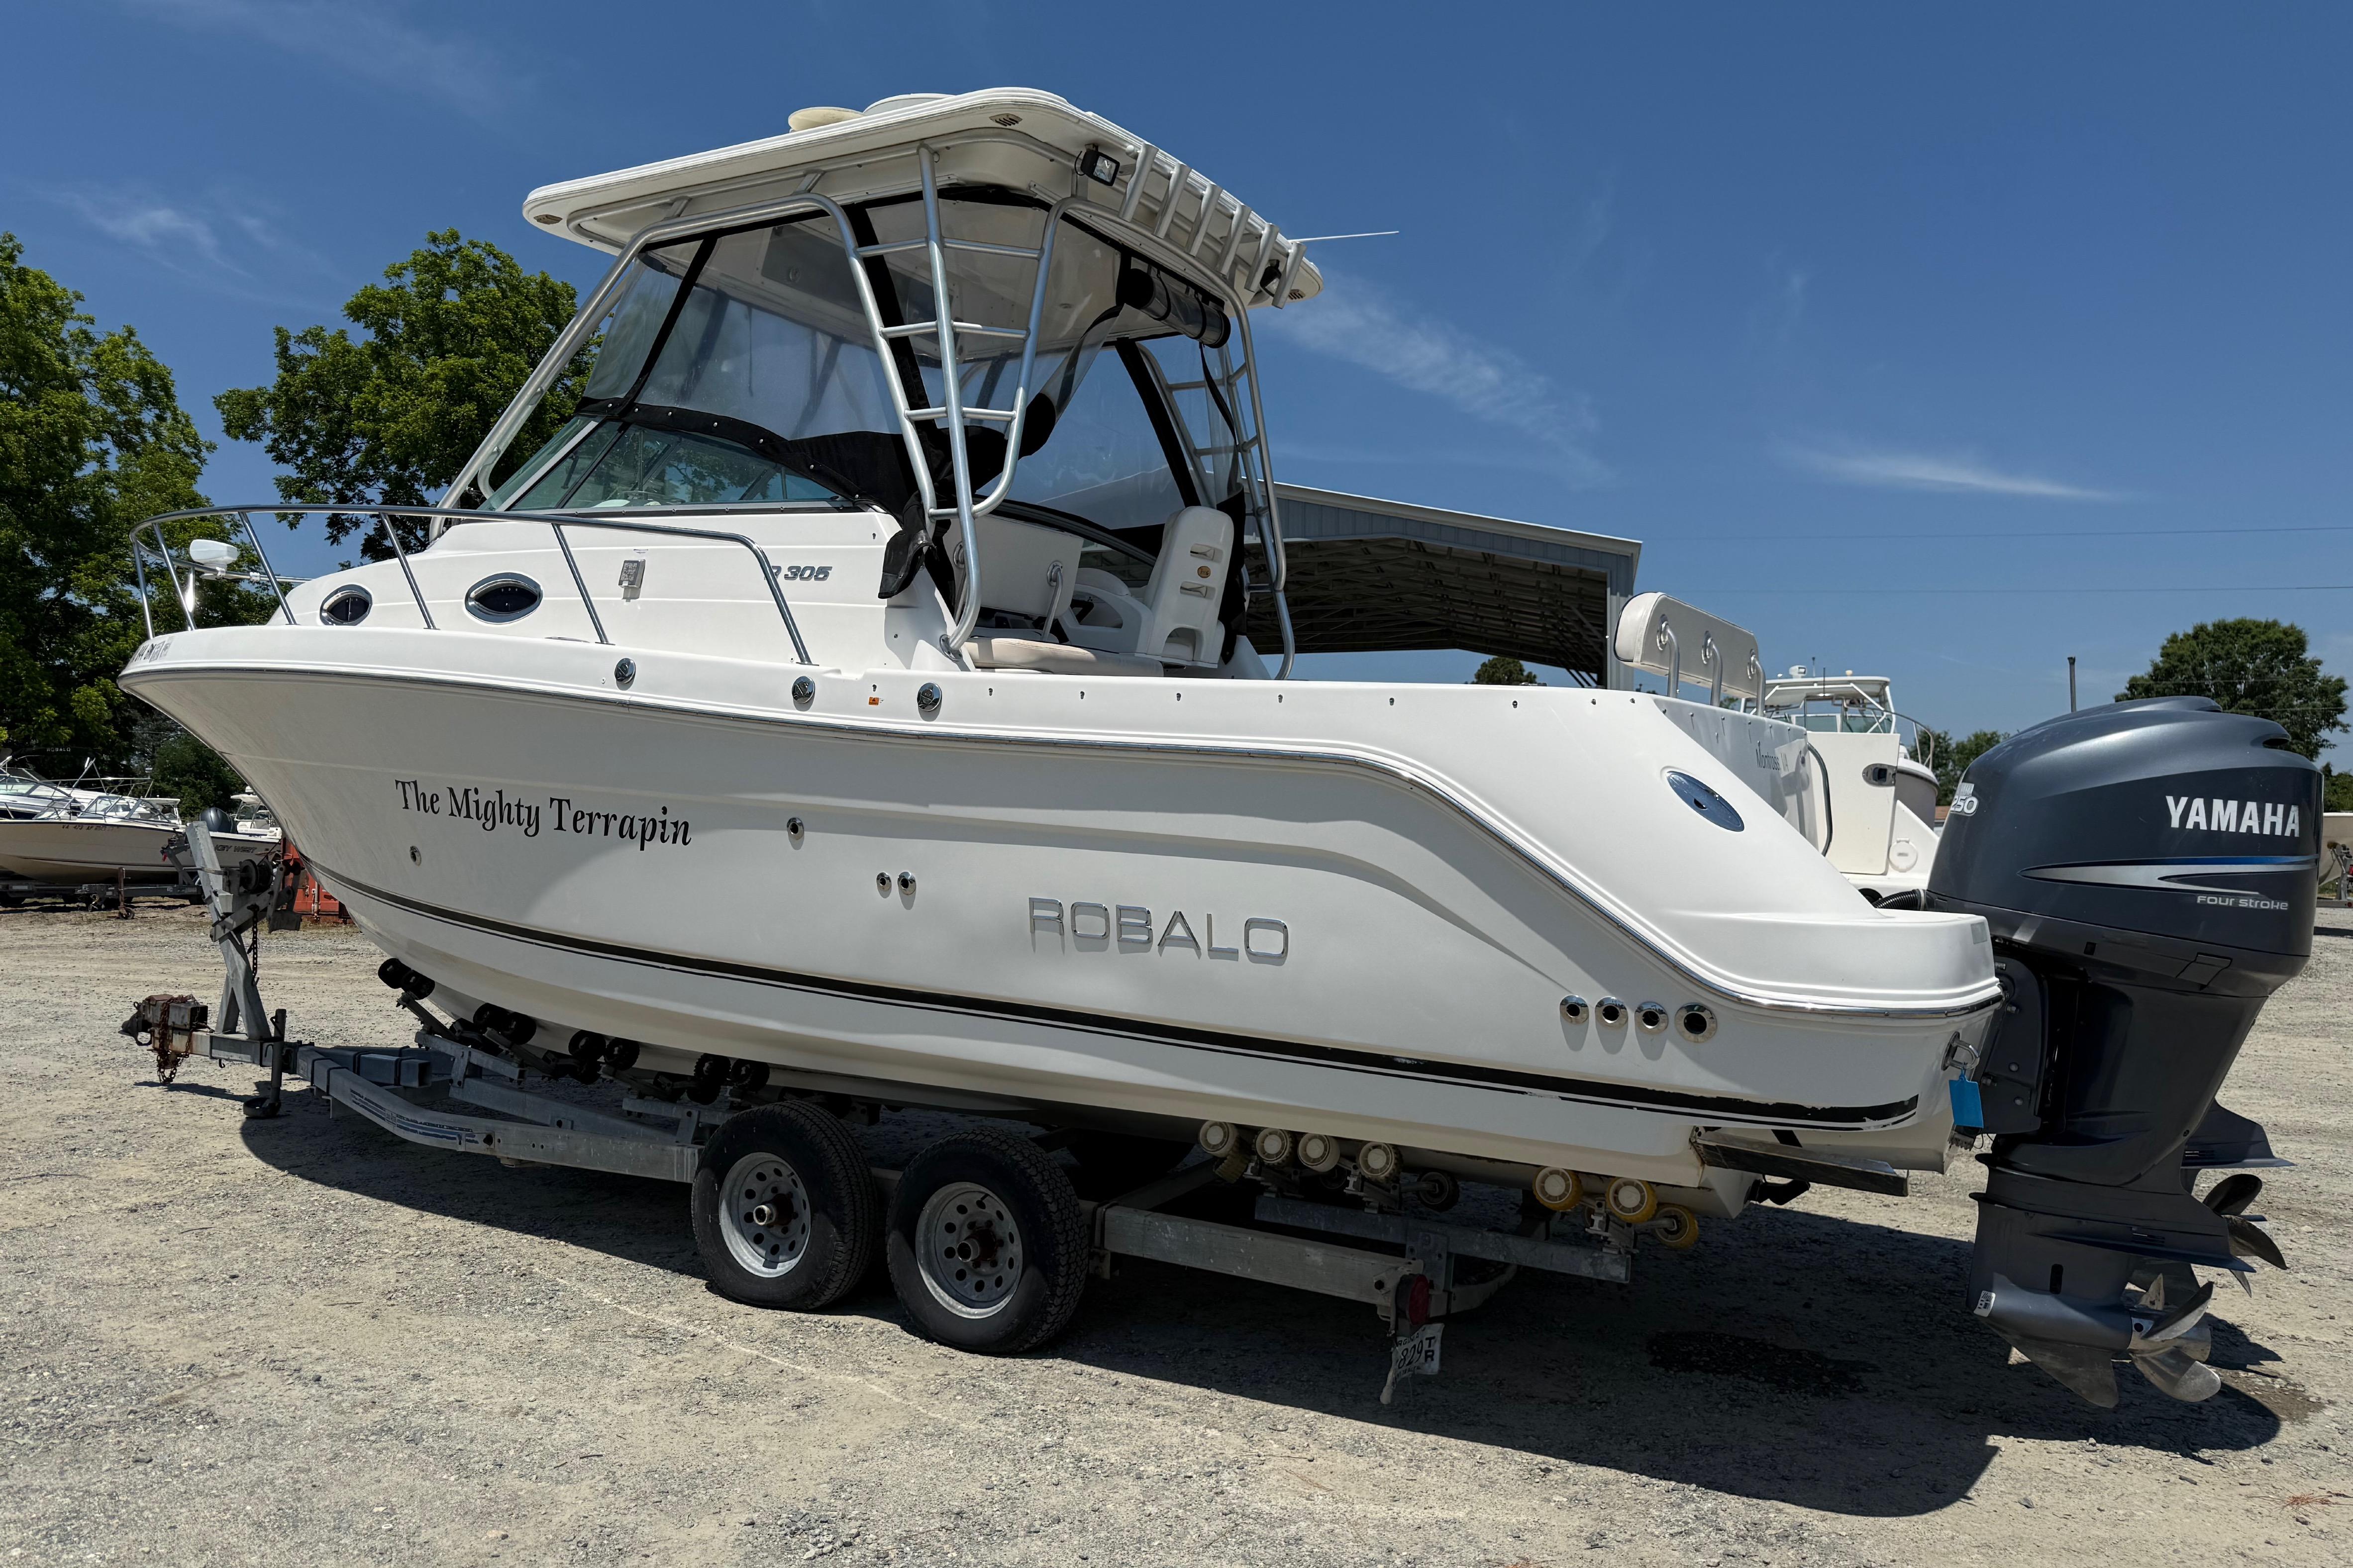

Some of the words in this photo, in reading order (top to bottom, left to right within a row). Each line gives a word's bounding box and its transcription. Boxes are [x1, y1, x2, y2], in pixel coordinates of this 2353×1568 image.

[784, 566, 832, 581] 305
[1780, 752, 1789, 772] VA
[395, 779, 440, 814] The
[446, 786, 540, 837] Mighty
[549, 796, 692, 851] Terrapin
[2165, 795, 2300, 837] YAMAHA
[1028, 897, 1289, 958] ROBALO
